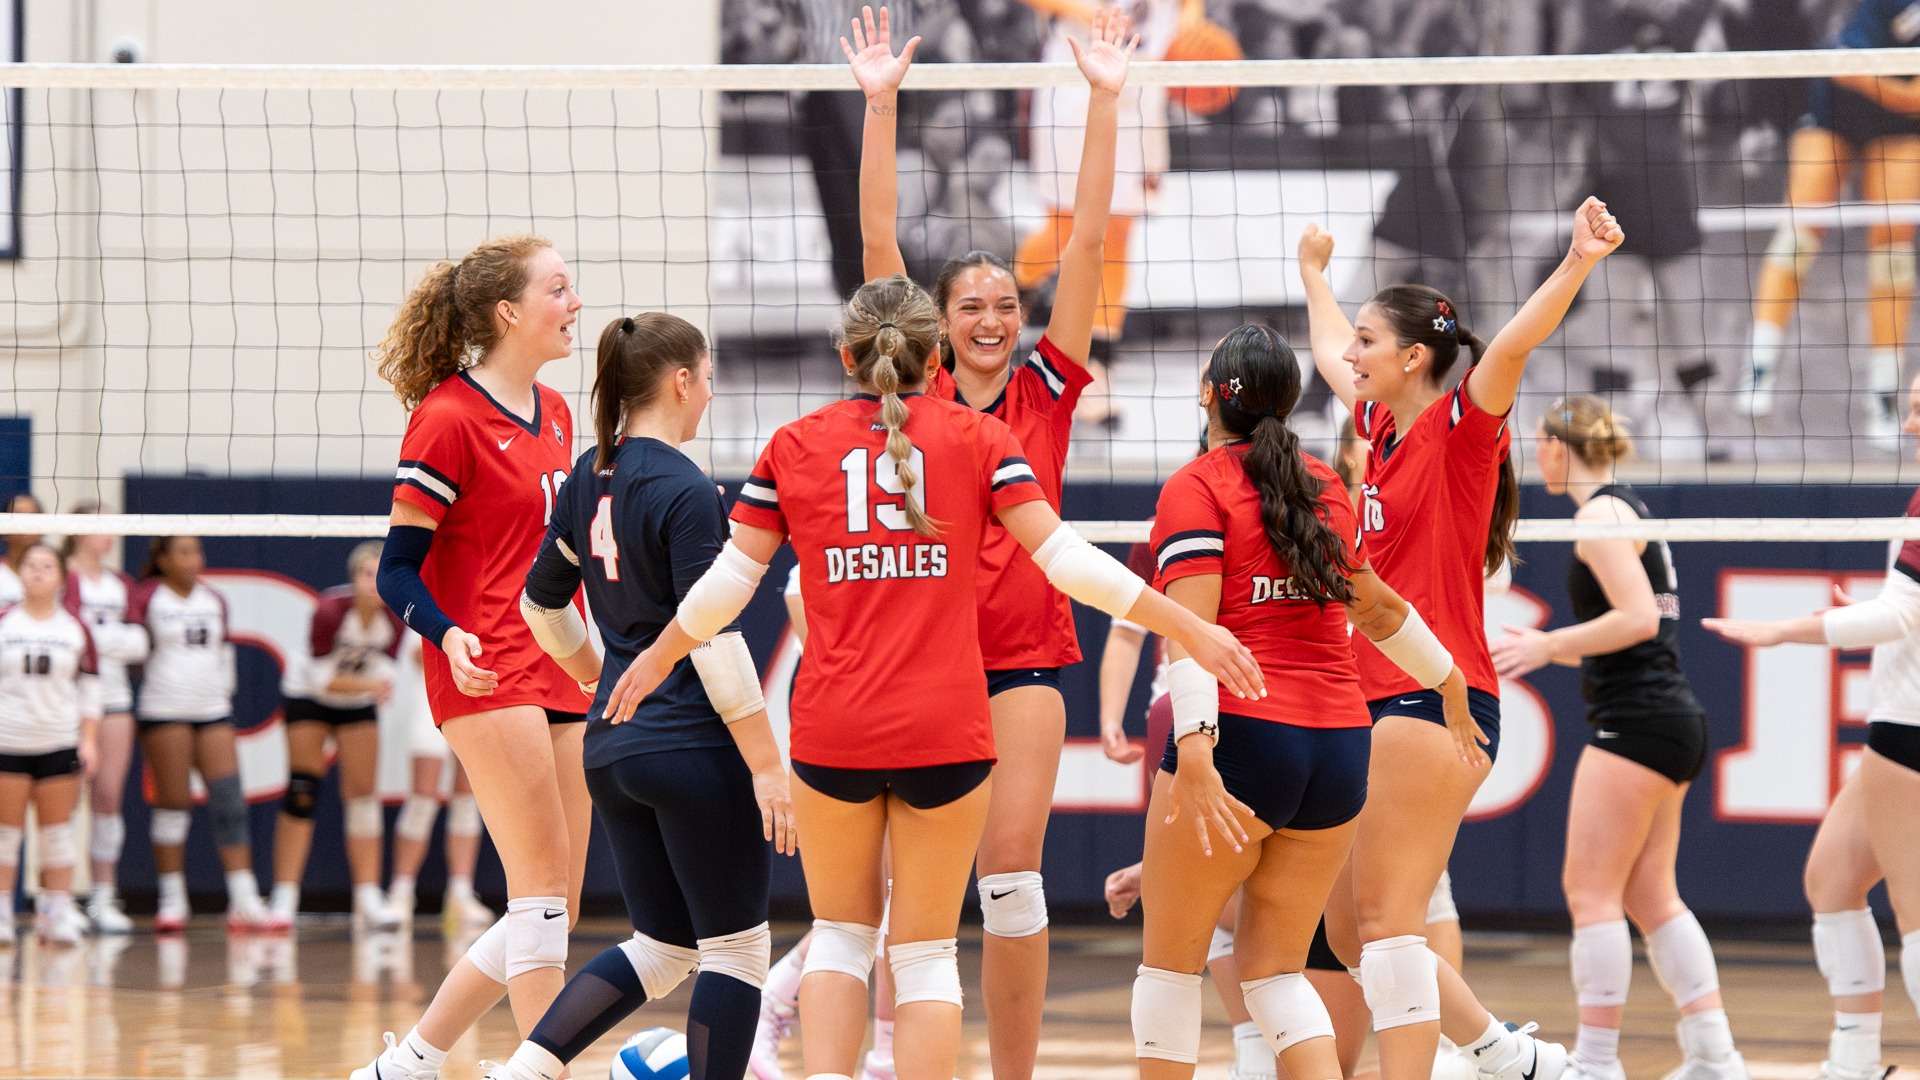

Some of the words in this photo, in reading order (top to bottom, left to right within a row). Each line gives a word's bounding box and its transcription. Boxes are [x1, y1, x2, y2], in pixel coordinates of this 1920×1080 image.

[840, 446, 926, 533] 19
[590, 495, 620, 582] 4
[825, 543, 948, 584] DESALES
